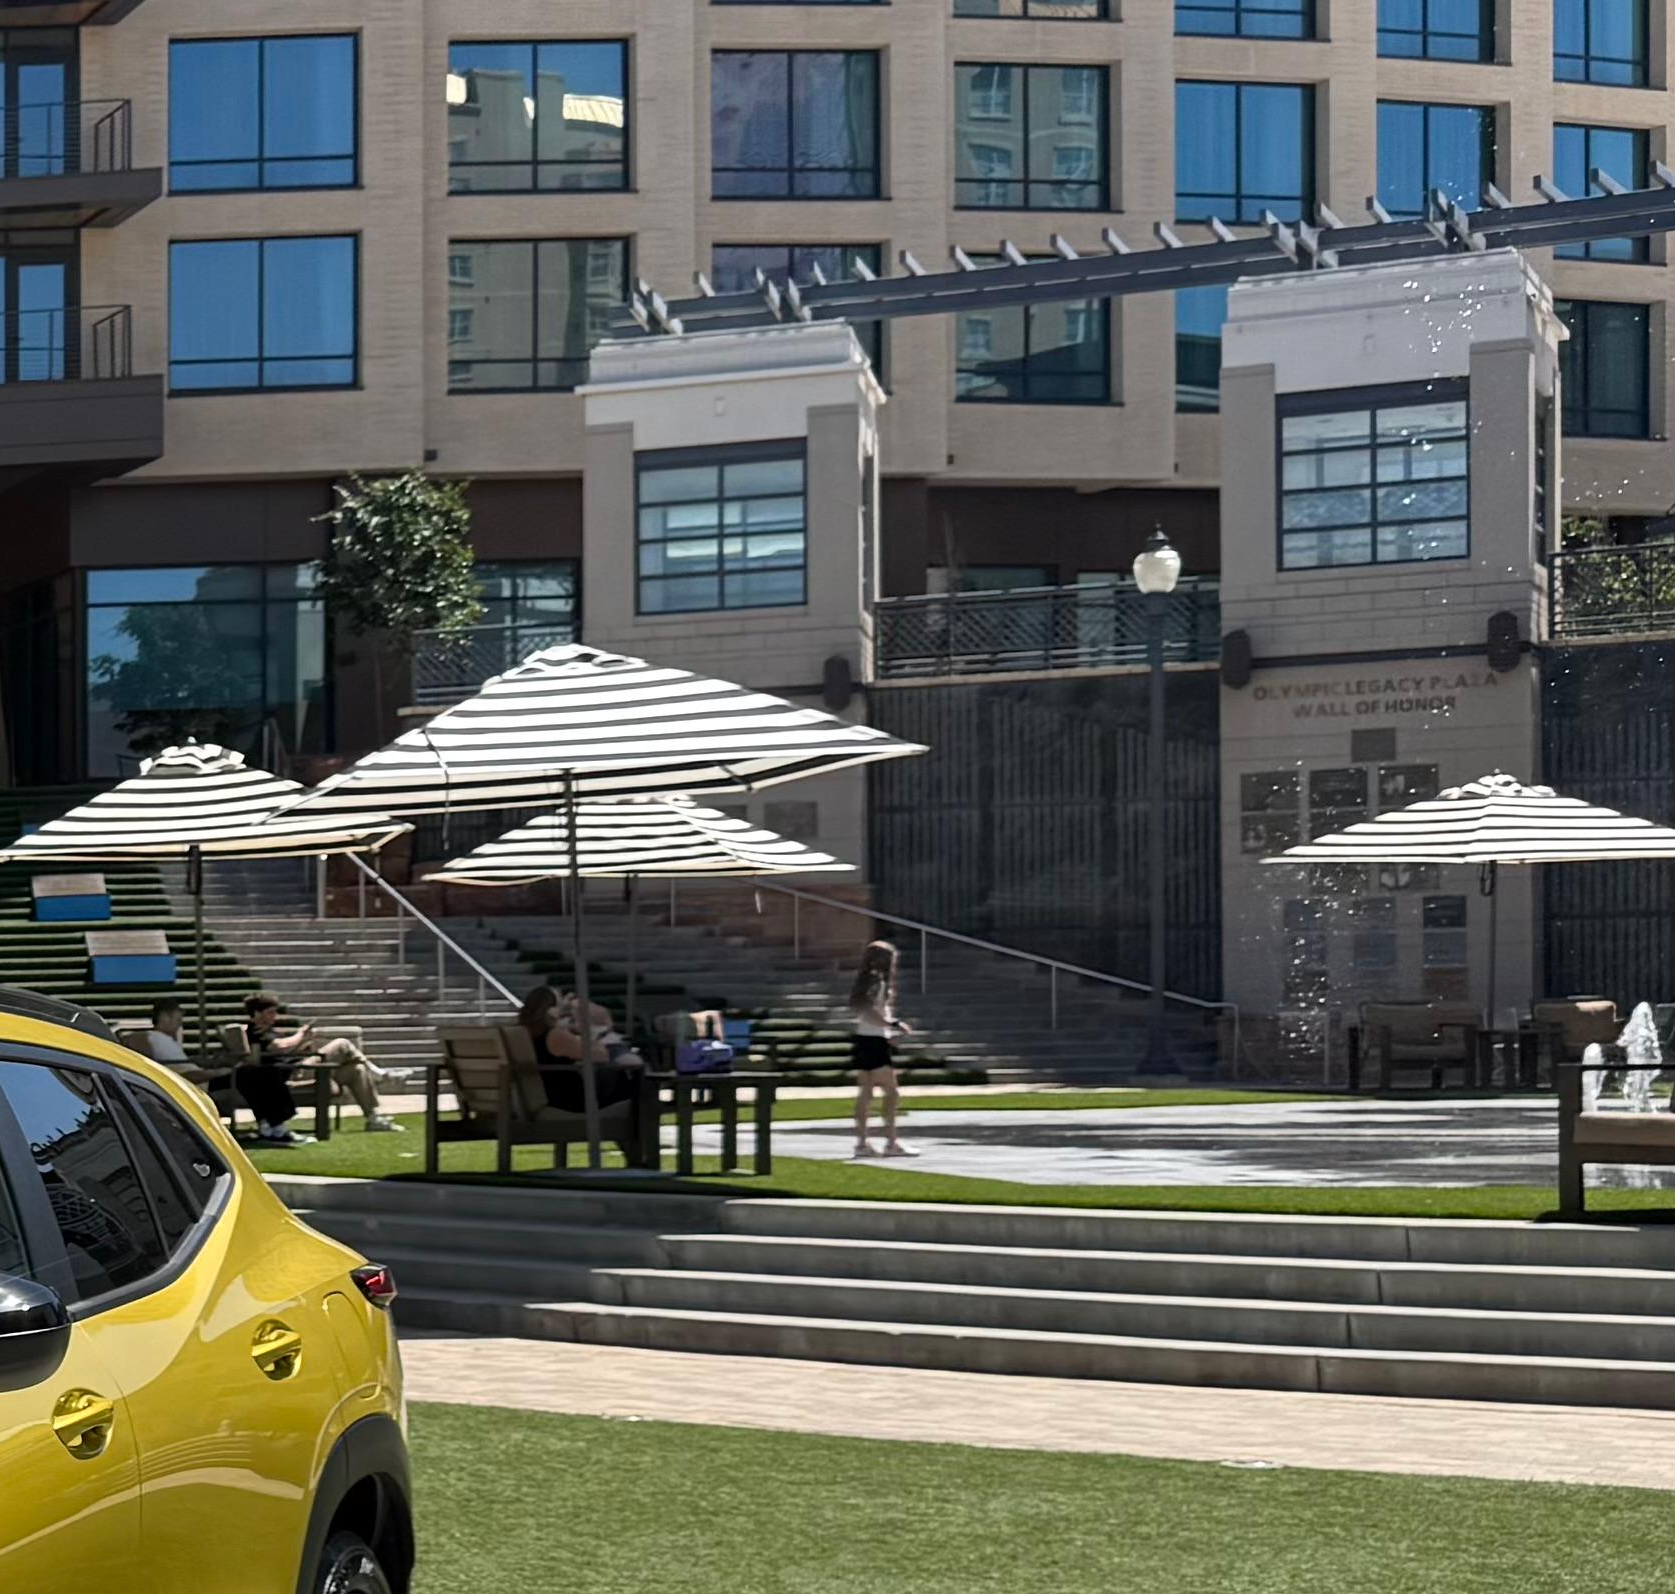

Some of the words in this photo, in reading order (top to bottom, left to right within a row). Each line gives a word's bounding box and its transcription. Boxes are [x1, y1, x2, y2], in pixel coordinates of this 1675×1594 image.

[1253, 681, 1341, 701] OLYMPIC
[1345, 677, 1425, 697] LEGACY
[1430, 671, 1498, 691] PLAZA
[1294, 701, 1351, 719] WALL
[1356, 700, 1380, 716] OF
[1384, 696, 1456, 714] HONOR
